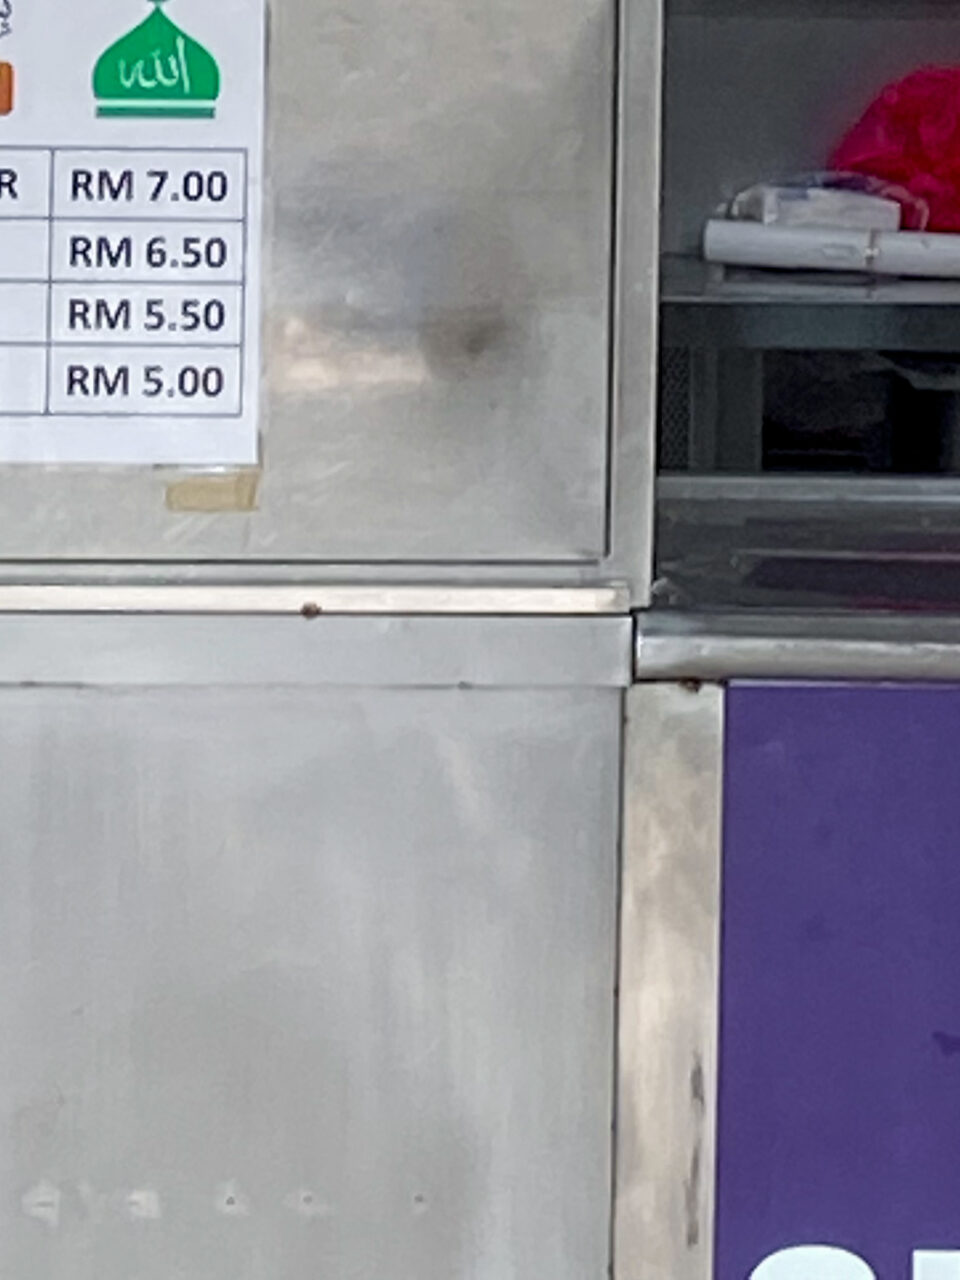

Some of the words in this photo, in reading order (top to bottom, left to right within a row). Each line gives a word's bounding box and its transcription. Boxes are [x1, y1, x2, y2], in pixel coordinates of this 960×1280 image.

[71, 169, 133, 201] RM
[147, 170, 228, 202] 7.00
[69, 236, 132, 268] RM
[146, 237, 227, 268] 6.50
[69, 299, 130, 330] RM
[145, 299, 225, 331] 5.50
[67, 365, 129, 396] RM
[144, 366, 223, 397] 5.00
